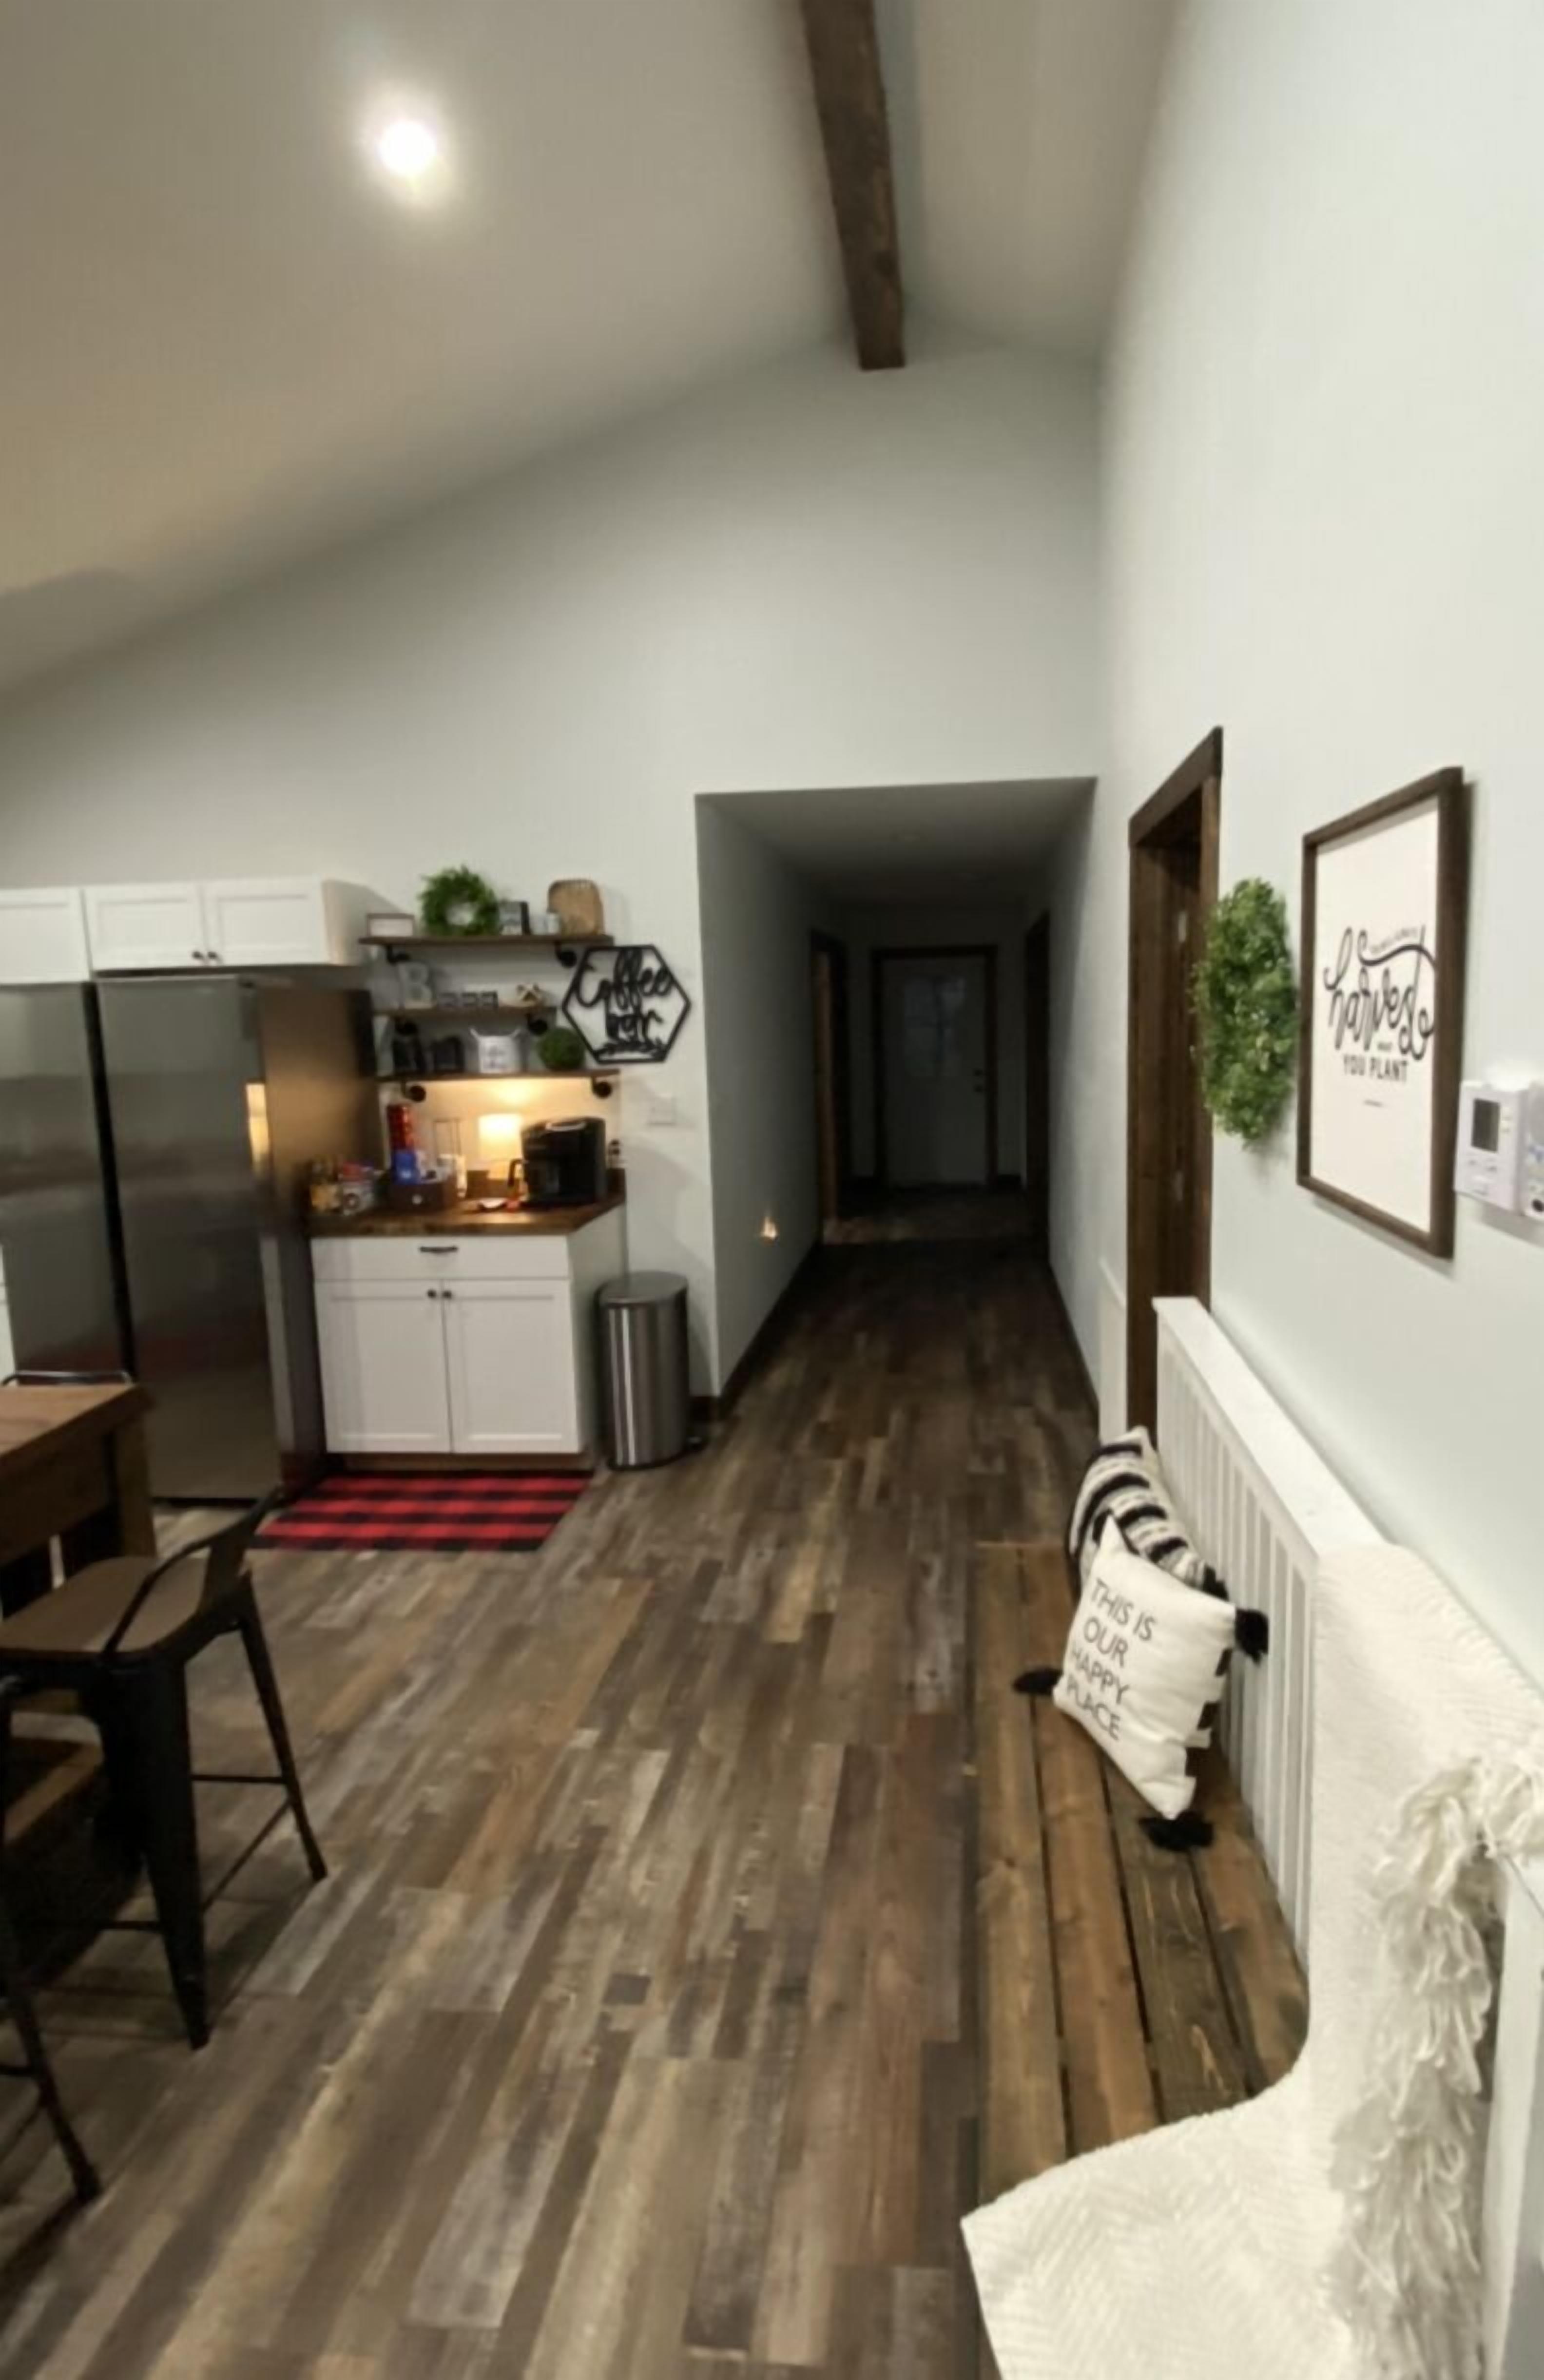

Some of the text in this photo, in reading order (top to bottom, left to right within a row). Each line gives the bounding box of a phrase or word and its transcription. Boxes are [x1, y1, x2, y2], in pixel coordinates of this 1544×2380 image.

[577, 948, 675, 1010] Coffee
[1343, 1050, 1407, 1083] YOU PLANT
[1091, 1578, 1157, 1641] THIS IS
[1084, 1616, 1128, 1669] OUR
[1072, 1644, 1130, 1705] HAPPY
[1066, 1675, 1121, 1741] PLACE
